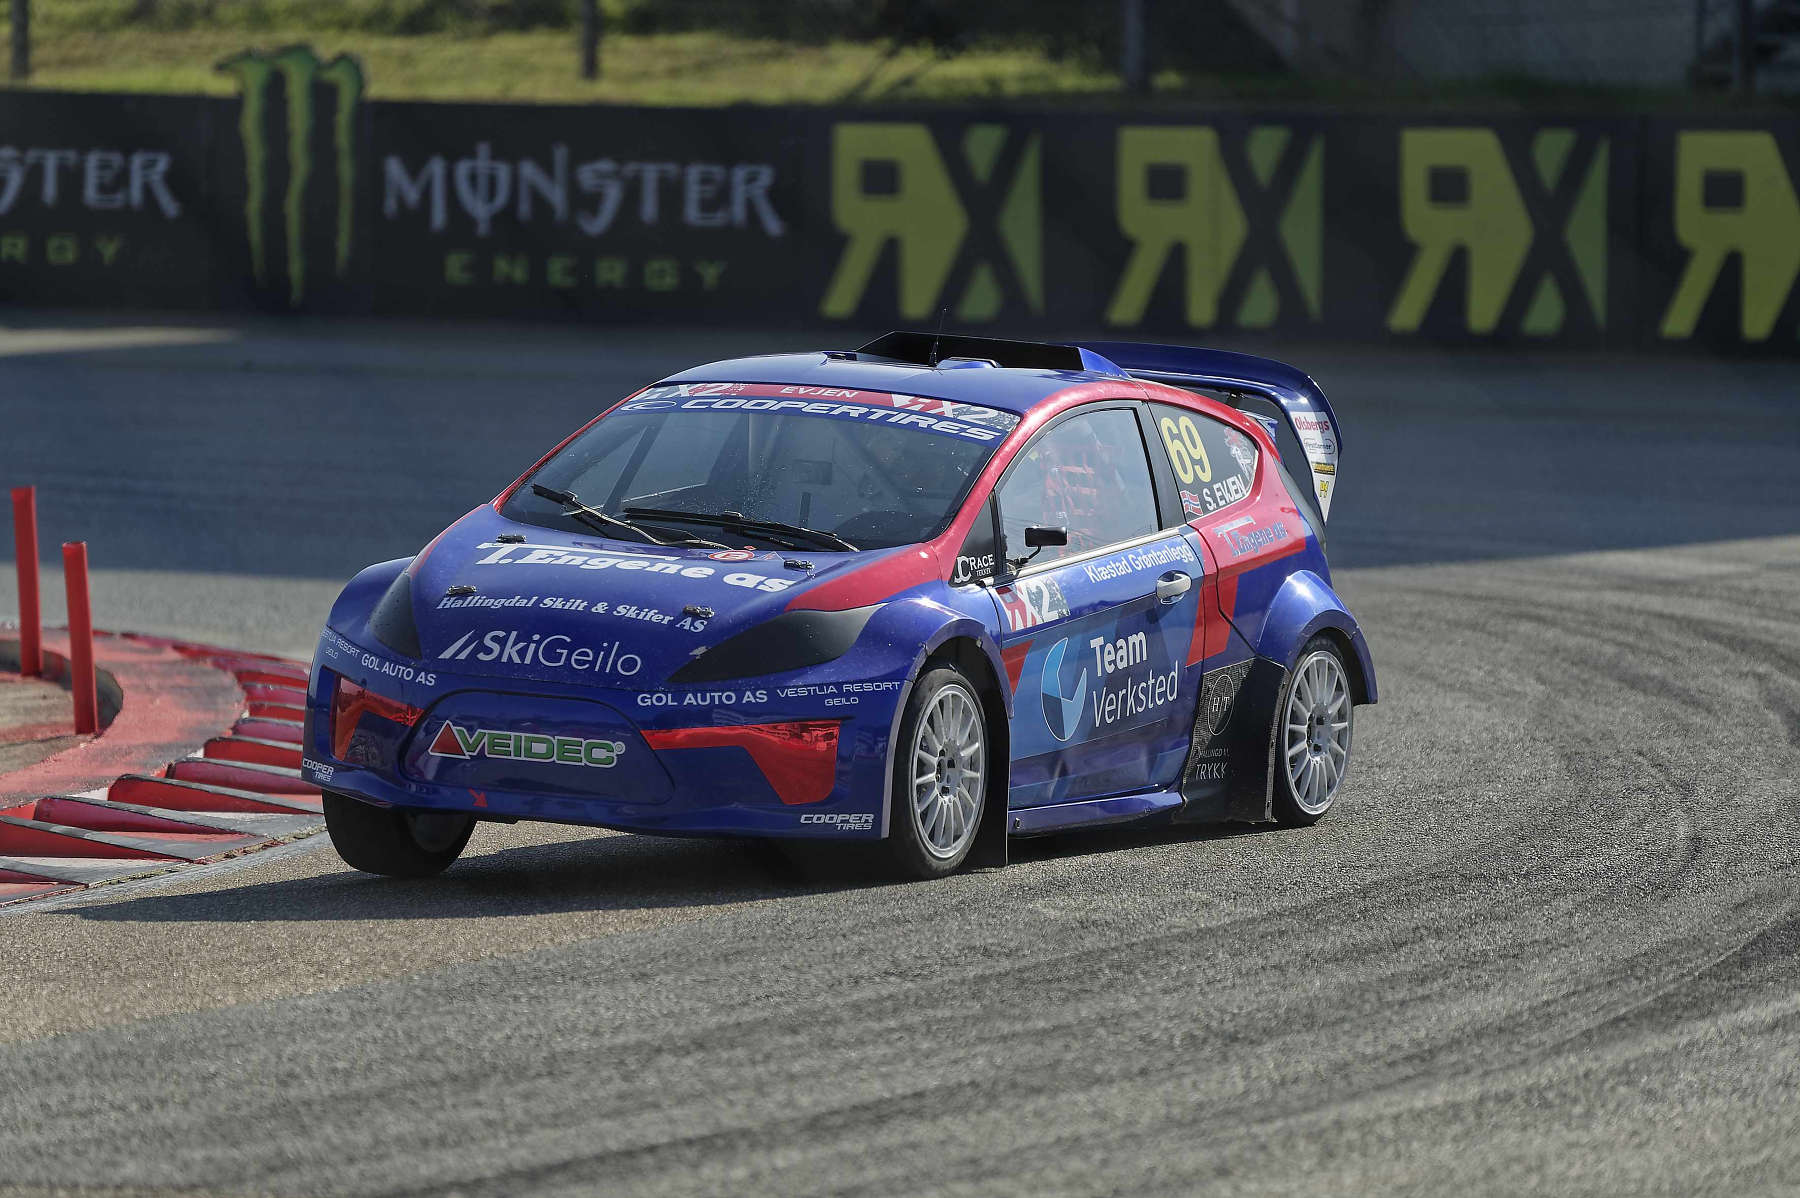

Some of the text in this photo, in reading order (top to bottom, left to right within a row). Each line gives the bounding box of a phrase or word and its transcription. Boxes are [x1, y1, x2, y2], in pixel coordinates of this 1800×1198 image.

[382, 143, 783, 237] MONSTER
[444, 251, 727, 292] ENERGY
[780, 386, 859, 399] EVJEN
[1294, 416, 1330, 434] Olsbergs
[1160, 416, 1212, 484] 69
[1202, 474, 1247, 511] S. EVJEN
[476, 542, 798, 593] T.Engene as
[970, 554, 995, 571] RACE
[1084, 543, 1195, 584] Klæstad Grøntanlegg
[436, 596, 708, 632] Hallingdal Skilt & Skifer AS
[336, 638, 361, 658] RESORT
[476, 630, 642, 677] SkiGeilo
[1090, 630, 1148, 677] Team
[361, 653, 437, 687] GOL AUTO AS
[637, 690, 768, 706] GOL AUTO AS
[776, 681, 901, 698] VESTLIA RESORT
[824, 697, 860, 707] GEILO
[1092, 660, 1179, 728] Verksted
[302, 758, 334, 776] COOPER
[315, 771, 332, 782] TIRES
[800, 813, 875, 824] COOPER
[835, 822, 873, 831] TIRES
